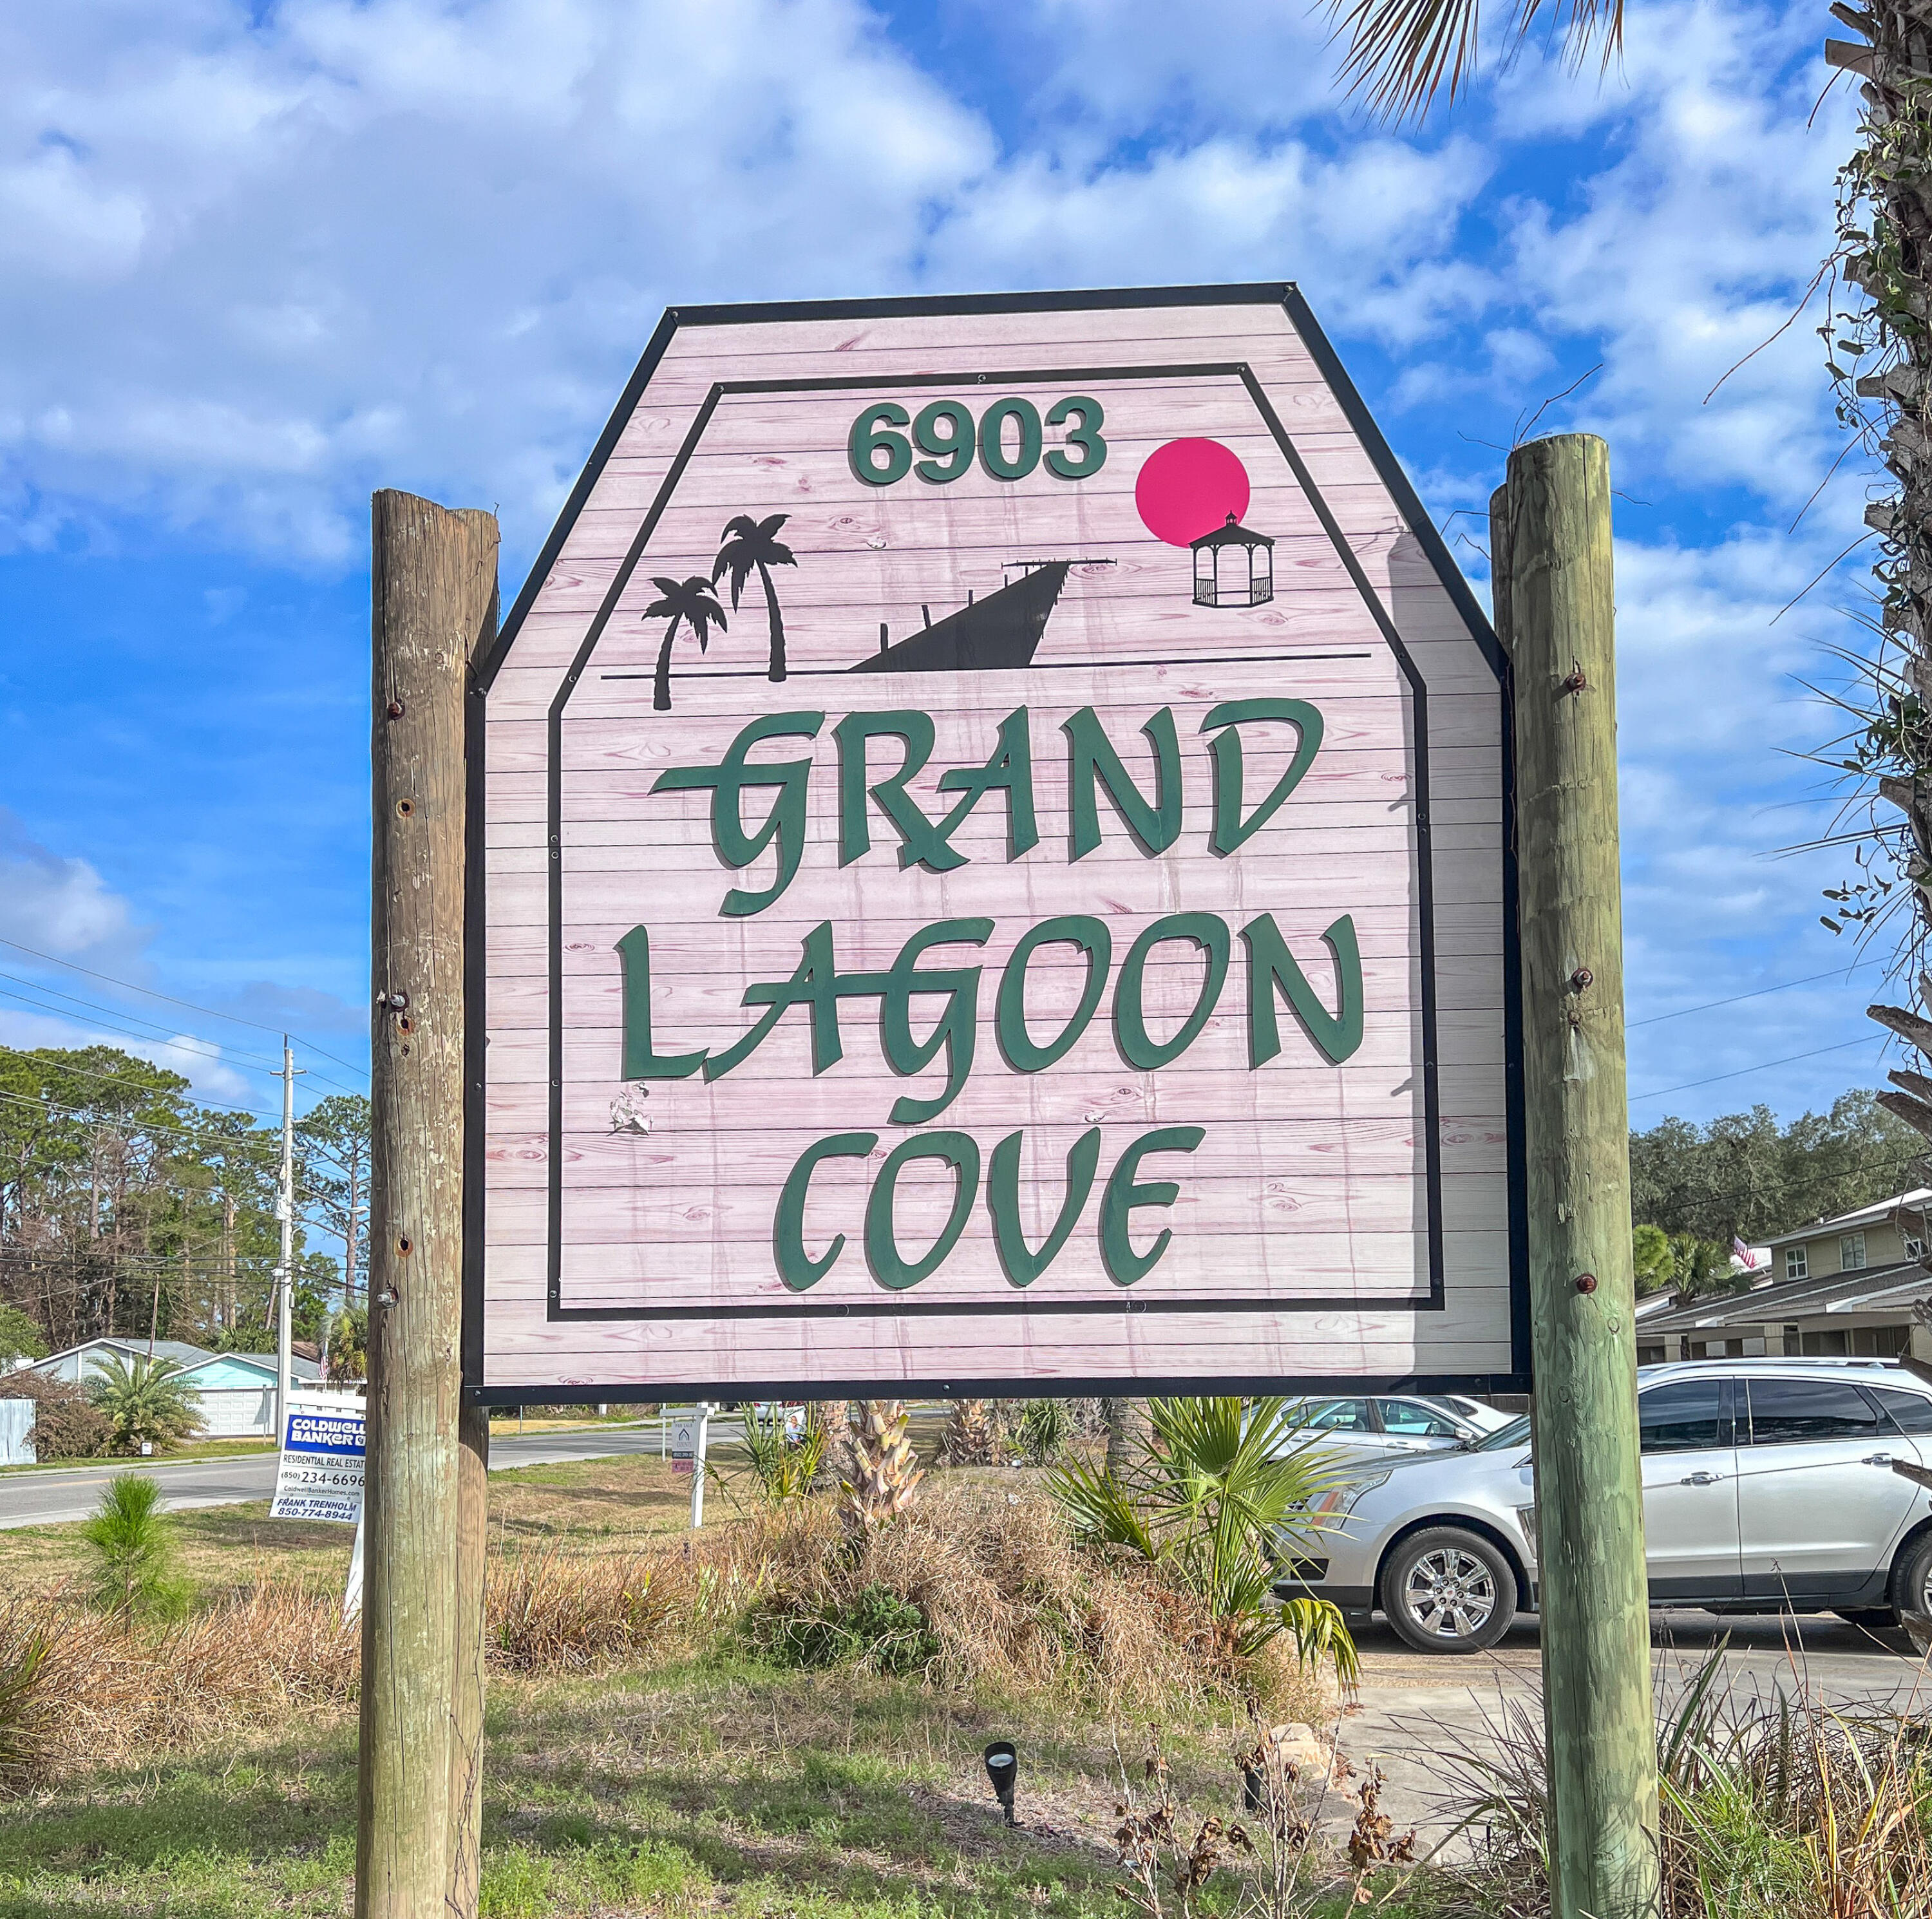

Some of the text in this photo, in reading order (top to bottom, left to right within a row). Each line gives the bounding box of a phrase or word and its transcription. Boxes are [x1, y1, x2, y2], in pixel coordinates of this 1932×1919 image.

[850, 396, 1107, 484] 6903
[652, 699, 1323, 916] GRAND
[616, 913, 1362, 1124] LAGOON
[775, 1127, 1203, 1290] COVE
[283, 1454, 365, 1469] RESIDENTIAL REAL ESTAT
[301, 1471, 365, 1487] 234-6696
[278, 1498, 357, 1511] FRANK TRENHOLM
[278, 1508, 353, 1520] 850-774-8944
